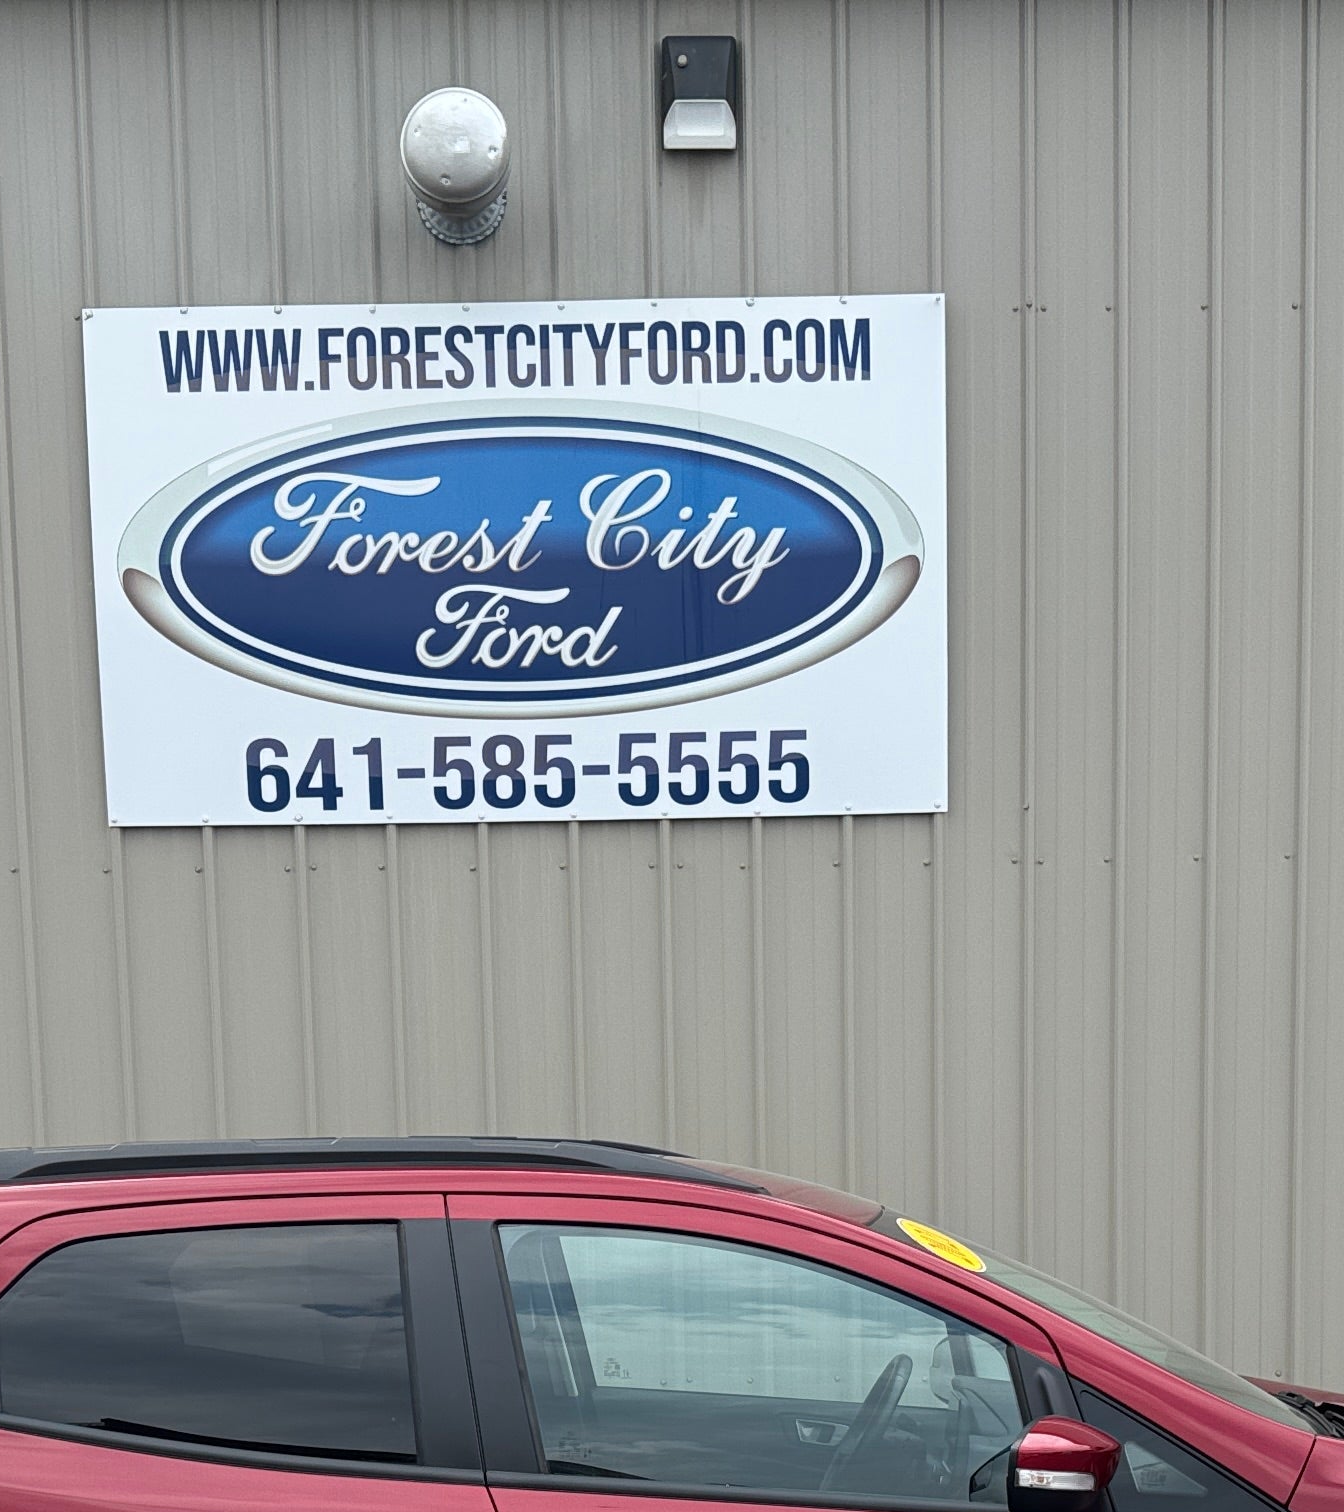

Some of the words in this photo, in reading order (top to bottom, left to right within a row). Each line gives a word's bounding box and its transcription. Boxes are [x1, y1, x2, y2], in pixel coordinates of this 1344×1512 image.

[159, 318, 871, 393] WWW.FORESTCITYFORD.COM
[250, 471, 553, 576] Forest
[580, 468, 791, 605] City
[416, 584, 619, 669] Ford
[246, 730, 810, 813] 641-585-5555
